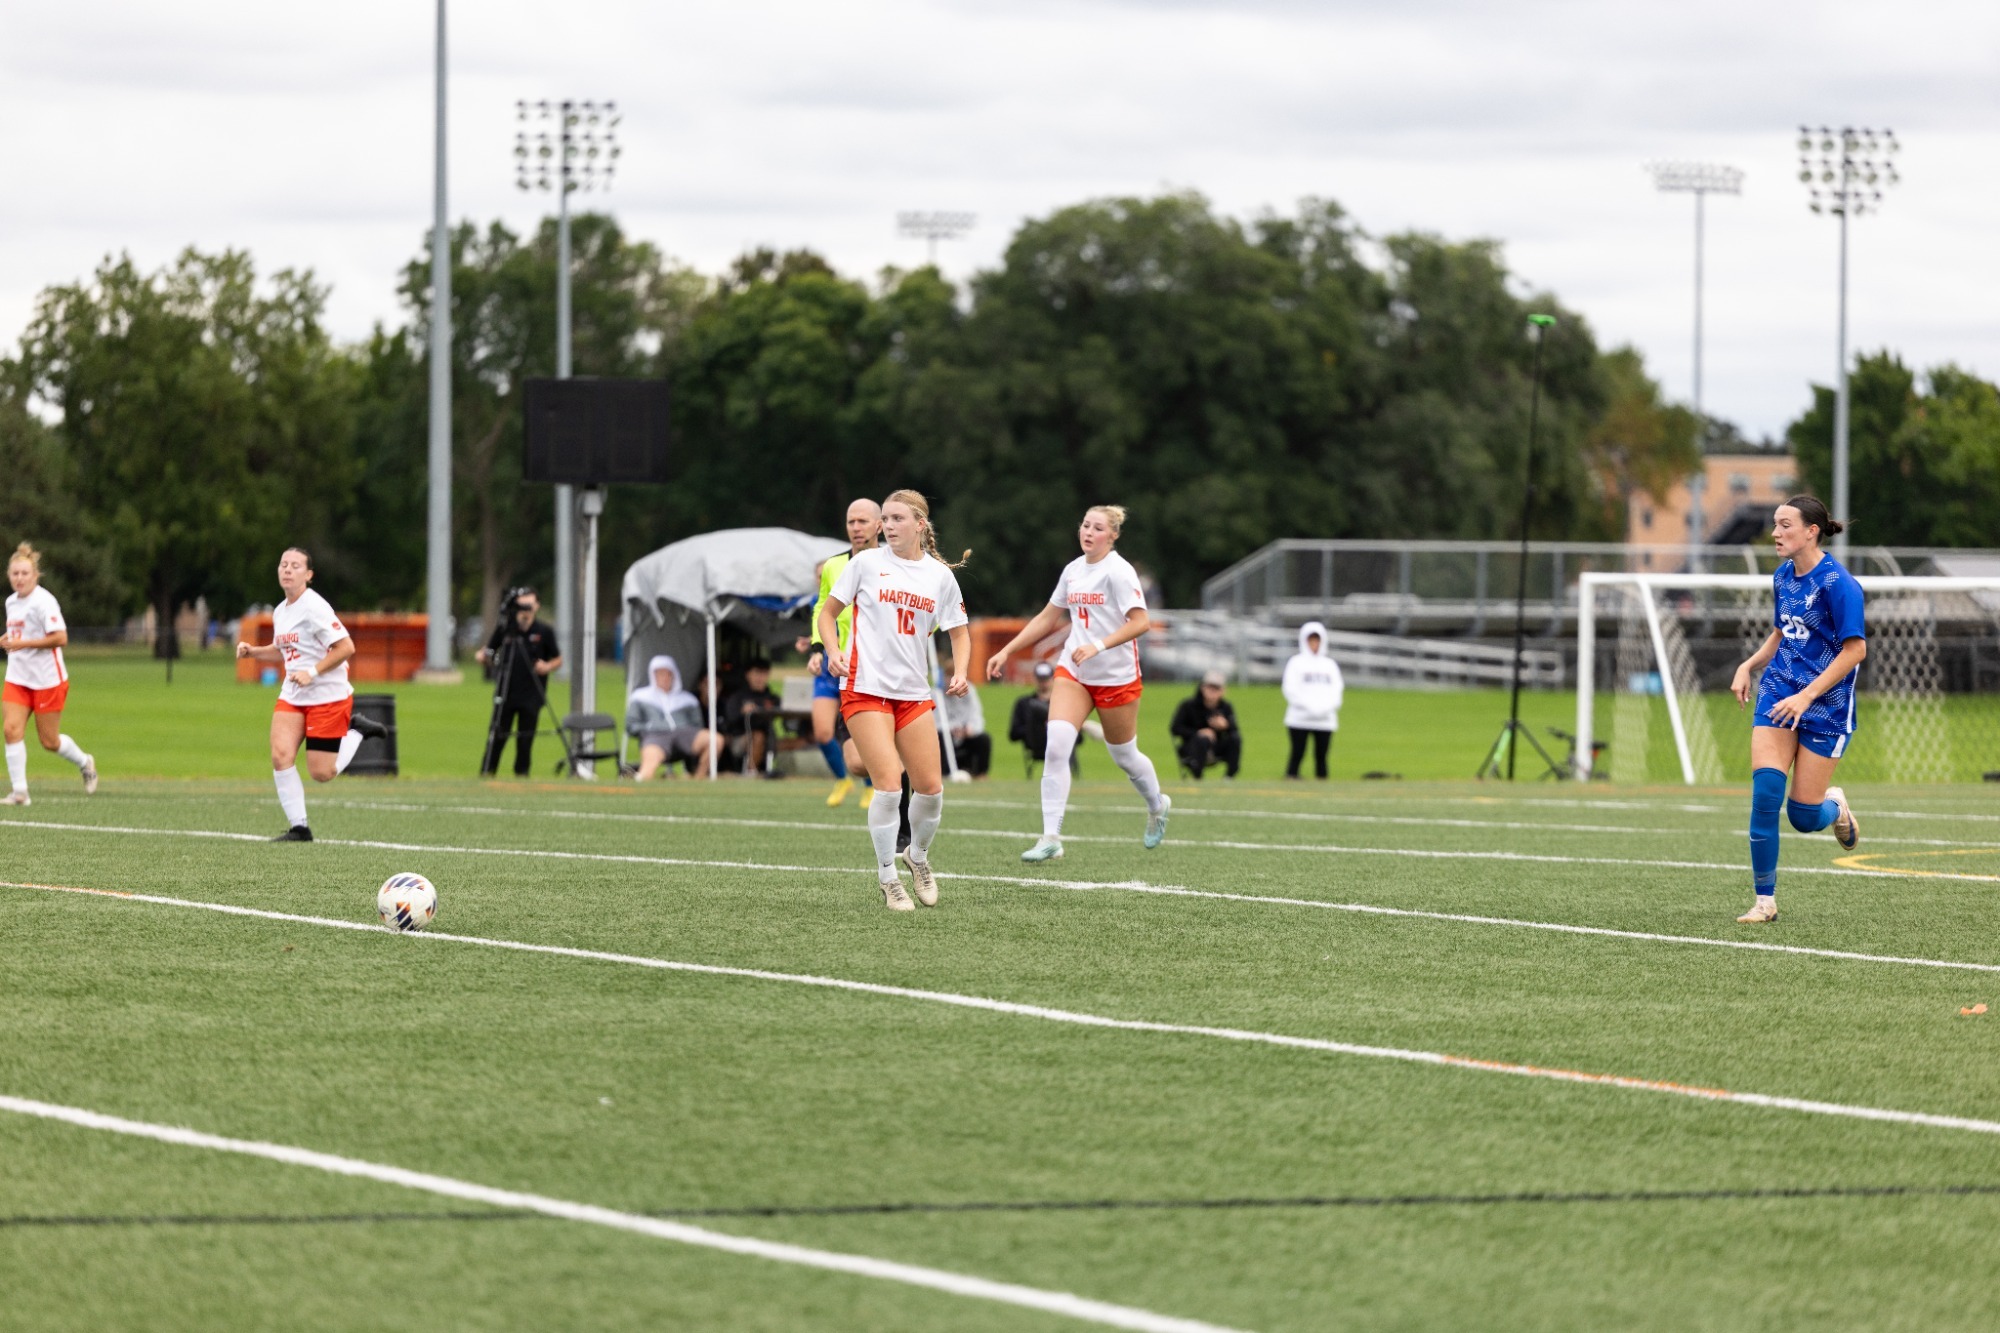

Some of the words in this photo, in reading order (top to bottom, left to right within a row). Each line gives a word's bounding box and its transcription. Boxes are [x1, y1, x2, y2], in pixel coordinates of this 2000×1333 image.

[879, 588, 936, 614] WARTBURG
[1078, 606, 1089, 629] 4
[1780, 614, 1810, 640] 26
